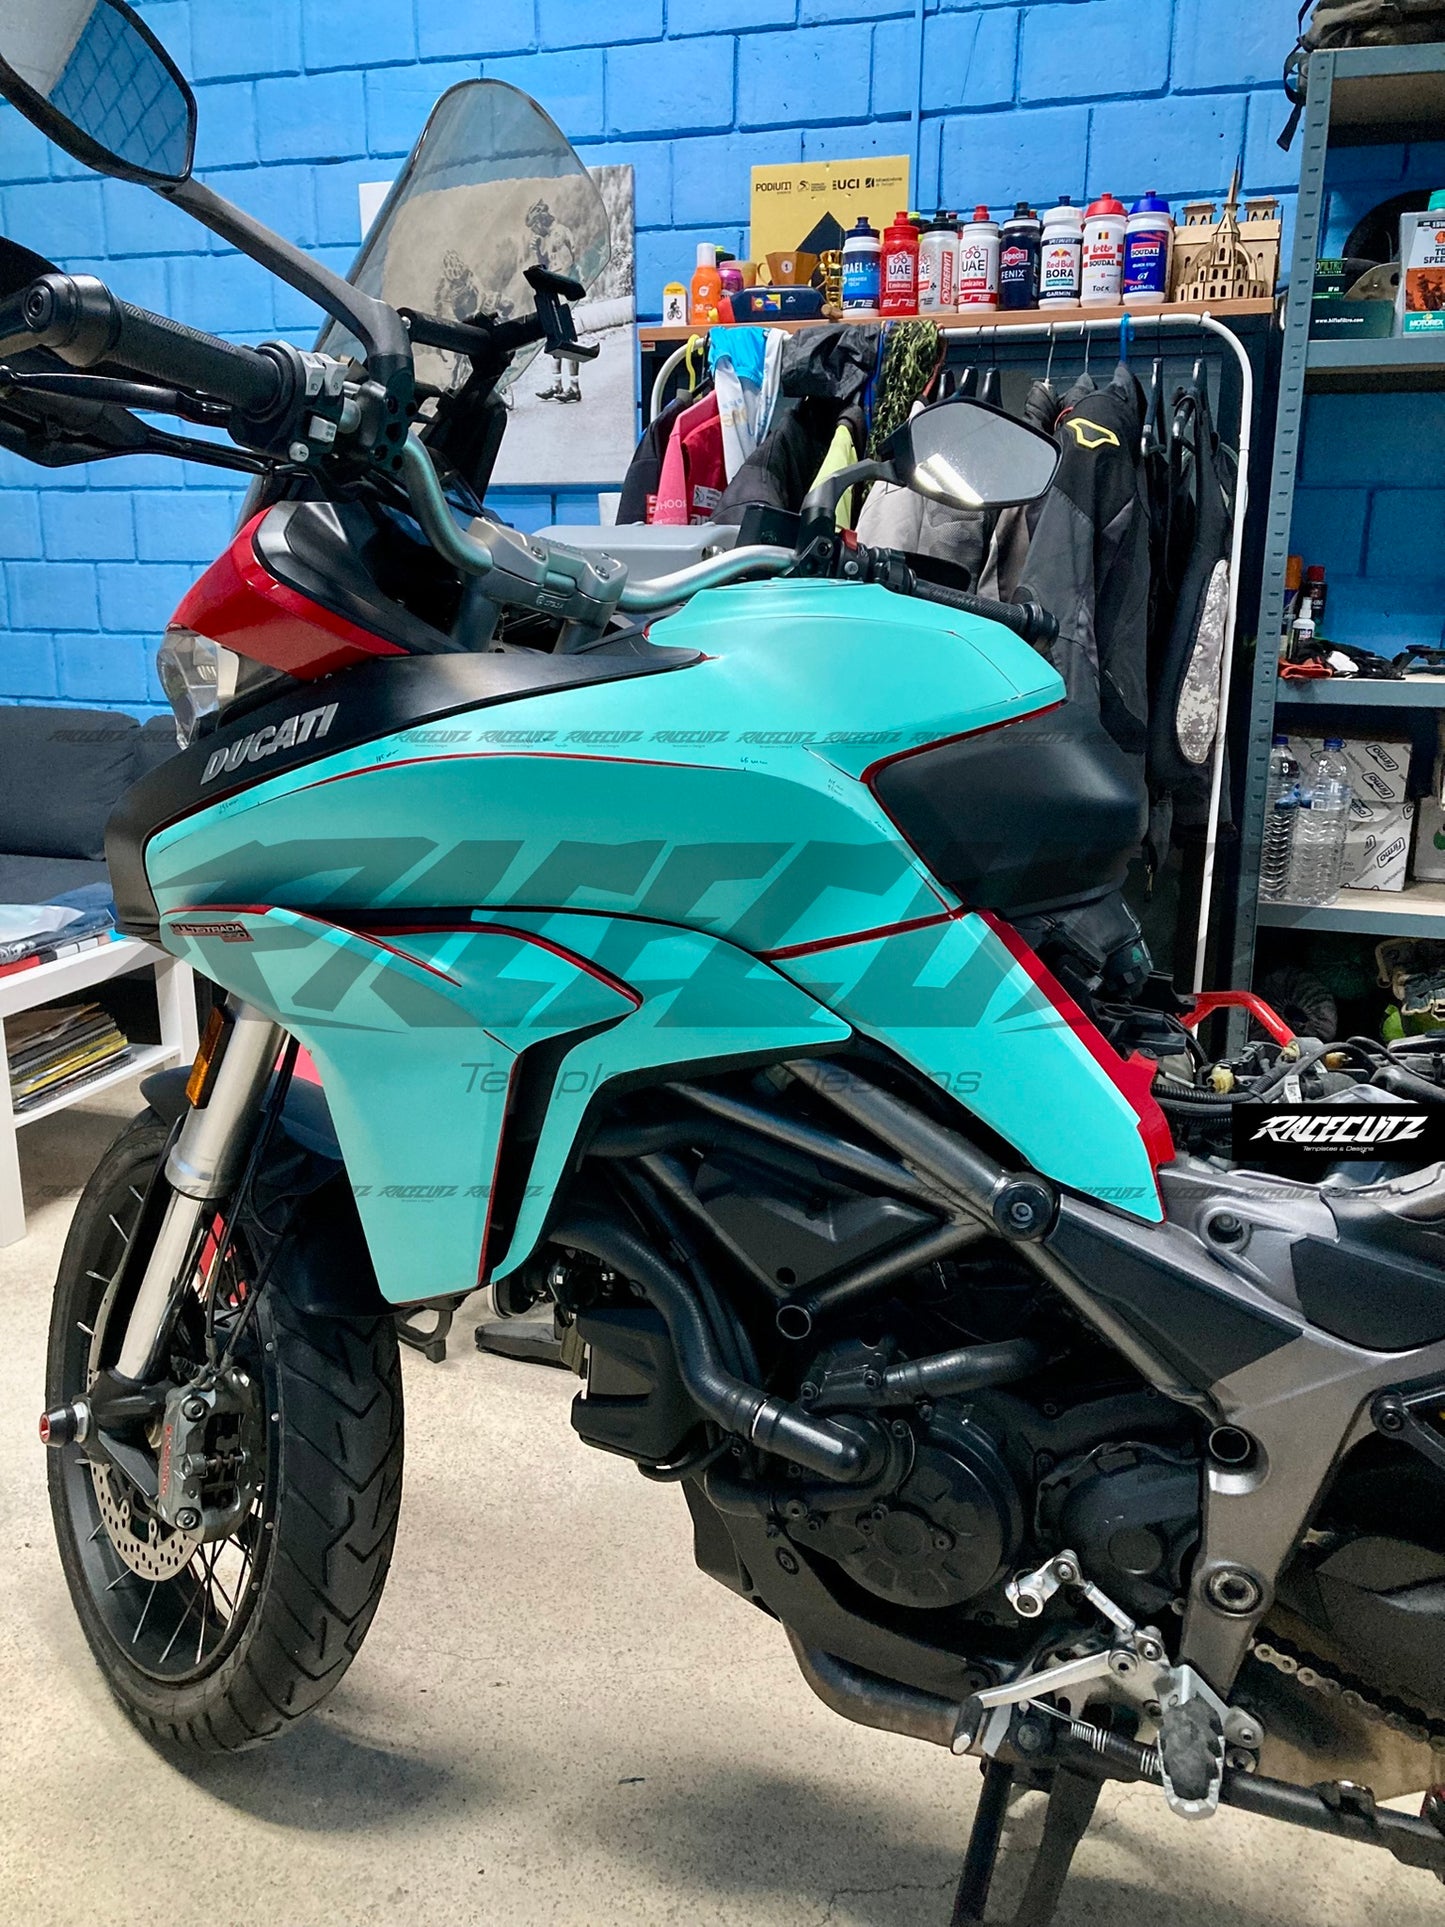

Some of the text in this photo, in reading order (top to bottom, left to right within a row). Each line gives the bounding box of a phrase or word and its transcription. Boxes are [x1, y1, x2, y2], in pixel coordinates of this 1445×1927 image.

[755, 182, 792, 192] PODIUM
[837, 179, 860, 190] UCI
[1003, 252, 1025, 262] Alpecin
[1131, 249, 1159, 257] SOUDAL
[842, 262, 864, 275] SRAEL
[962, 260, 985, 272] UAE
[1046, 259, 1075, 269] Red Bull
[1089, 259, 1116, 268] SOUDAL
[889, 264, 911, 275] UAE
[919, 264, 930, 275] AE
[1001, 269, 1024, 280] FENIX
[1046, 269, 1075, 279] BORA
[1409, 319, 1444, 327] MOTOREX
[200, 702, 339, 786] DUCATI
